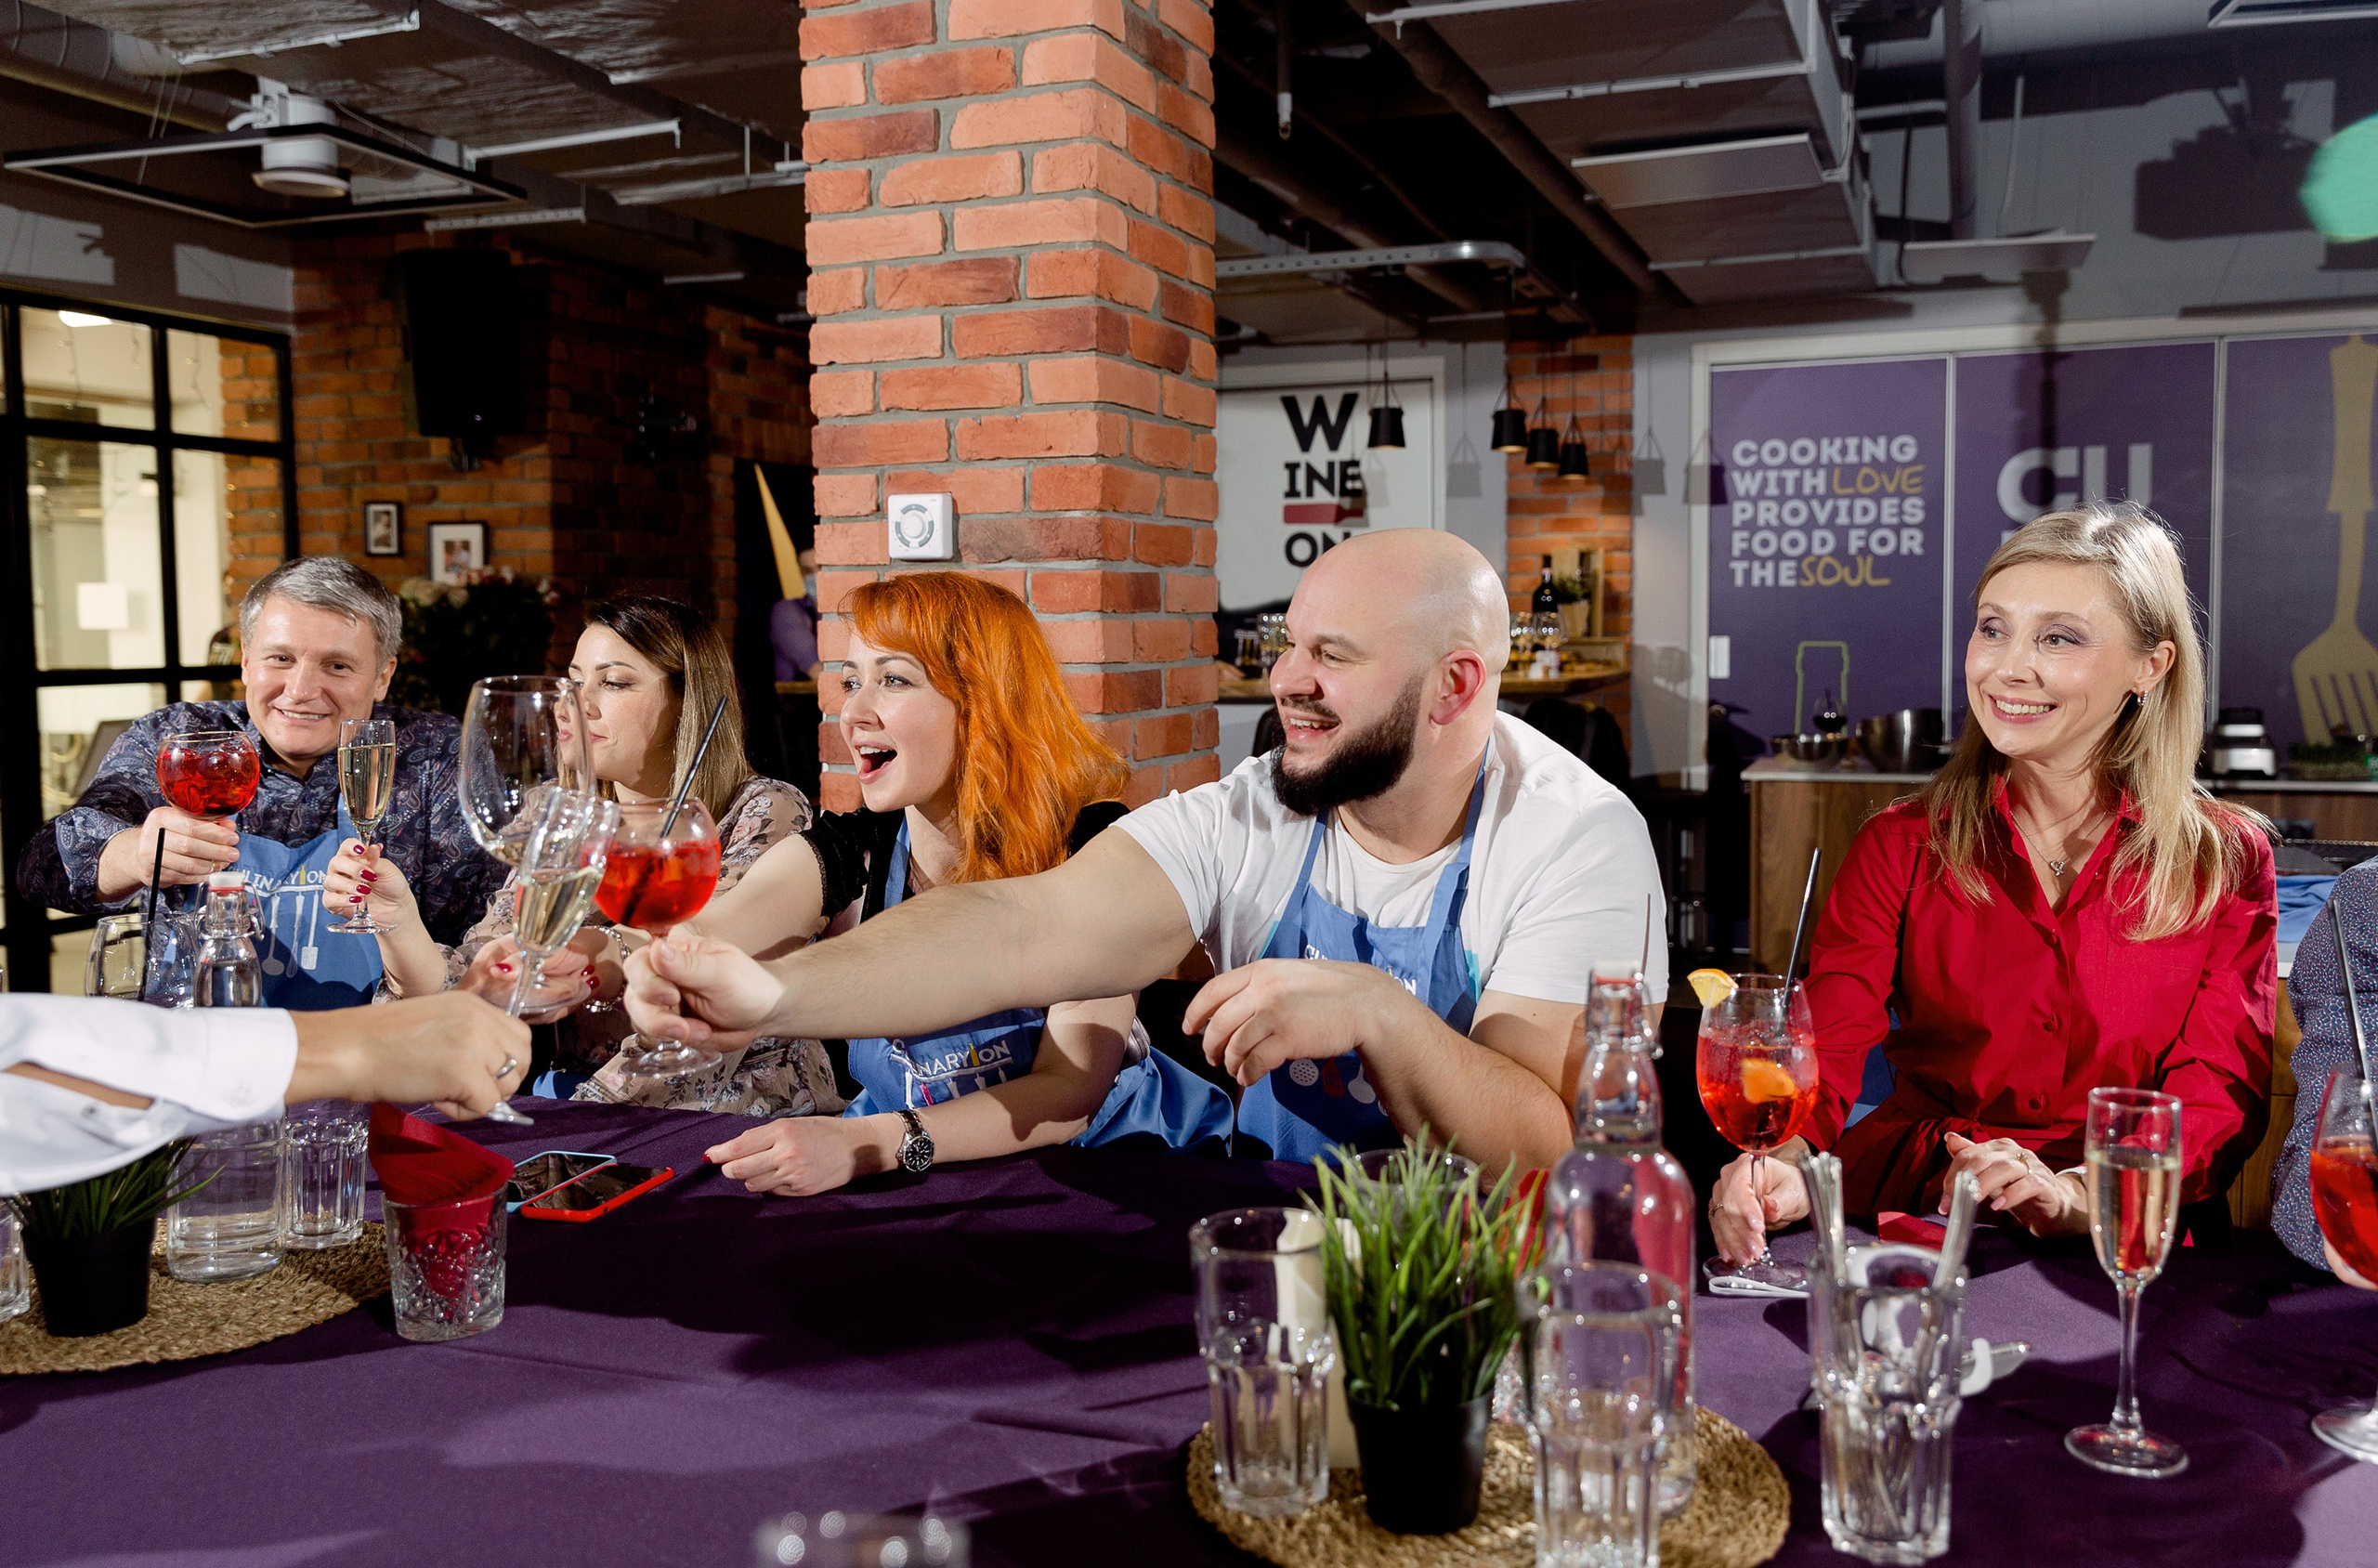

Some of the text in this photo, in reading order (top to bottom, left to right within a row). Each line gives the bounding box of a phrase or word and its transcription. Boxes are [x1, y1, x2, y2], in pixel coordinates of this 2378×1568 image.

[1280, 393, 1358, 452] W
[1731, 434, 1919, 466] COOKING
[1284, 461, 1362, 498] INE
[1731, 465, 1925, 497] WITH LOVE
[1731, 496, 1927, 528] PROVIDES
[1731, 528, 1925, 557] FOOD FOR
[1729, 555, 1890, 587] THE SOUL
